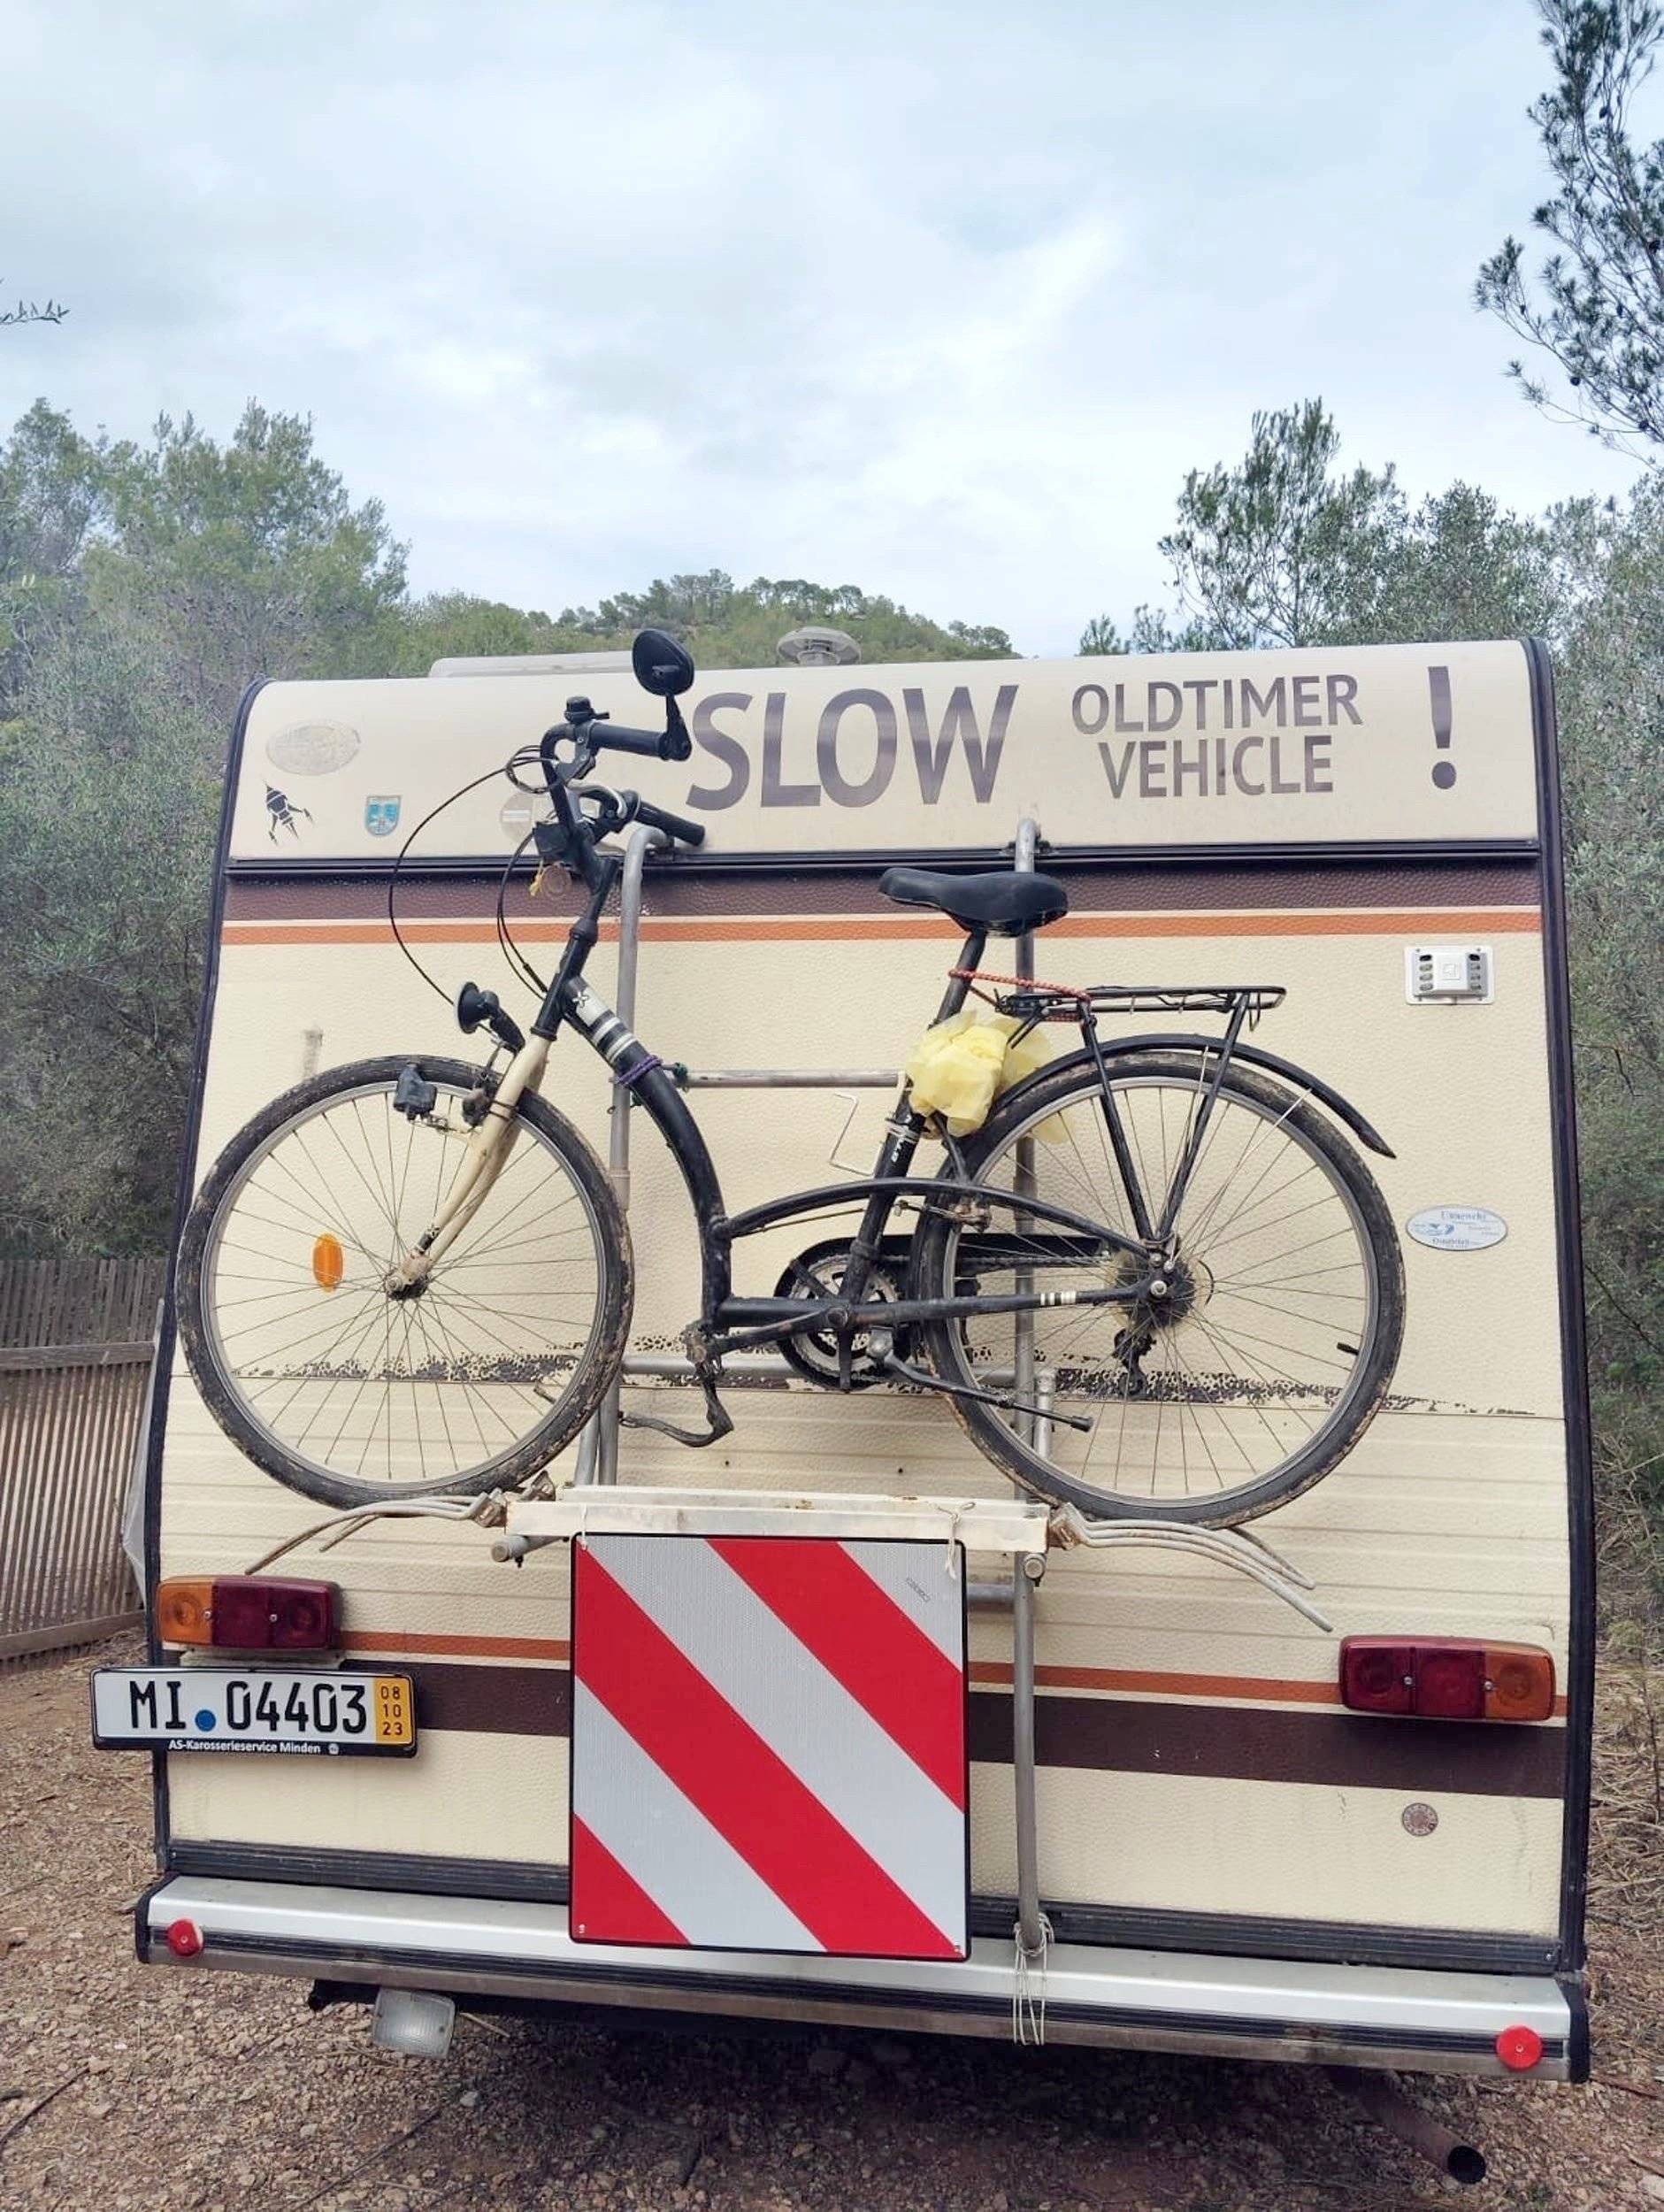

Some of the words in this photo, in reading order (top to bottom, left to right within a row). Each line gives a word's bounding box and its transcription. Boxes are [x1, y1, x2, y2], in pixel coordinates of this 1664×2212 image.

[1071, 674, 1363, 734] OLDTIMER
[1428, 666, 1457, 789] !
[686, 685, 1019, 810] SLOW
[1098, 735, 1333, 798] VEHICLE
[129, 1680, 187, 1729] MI
[226, 1680, 366, 1734] 04403
[380, 1686, 401, 1701] 08
[382, 1703, 402, 1718] 10
[168, 1739, 278, 1753] AS-Karosserieservice
[280, 1742, 321, 1755] Minden
[382, 1721, 403, 1736] 23
